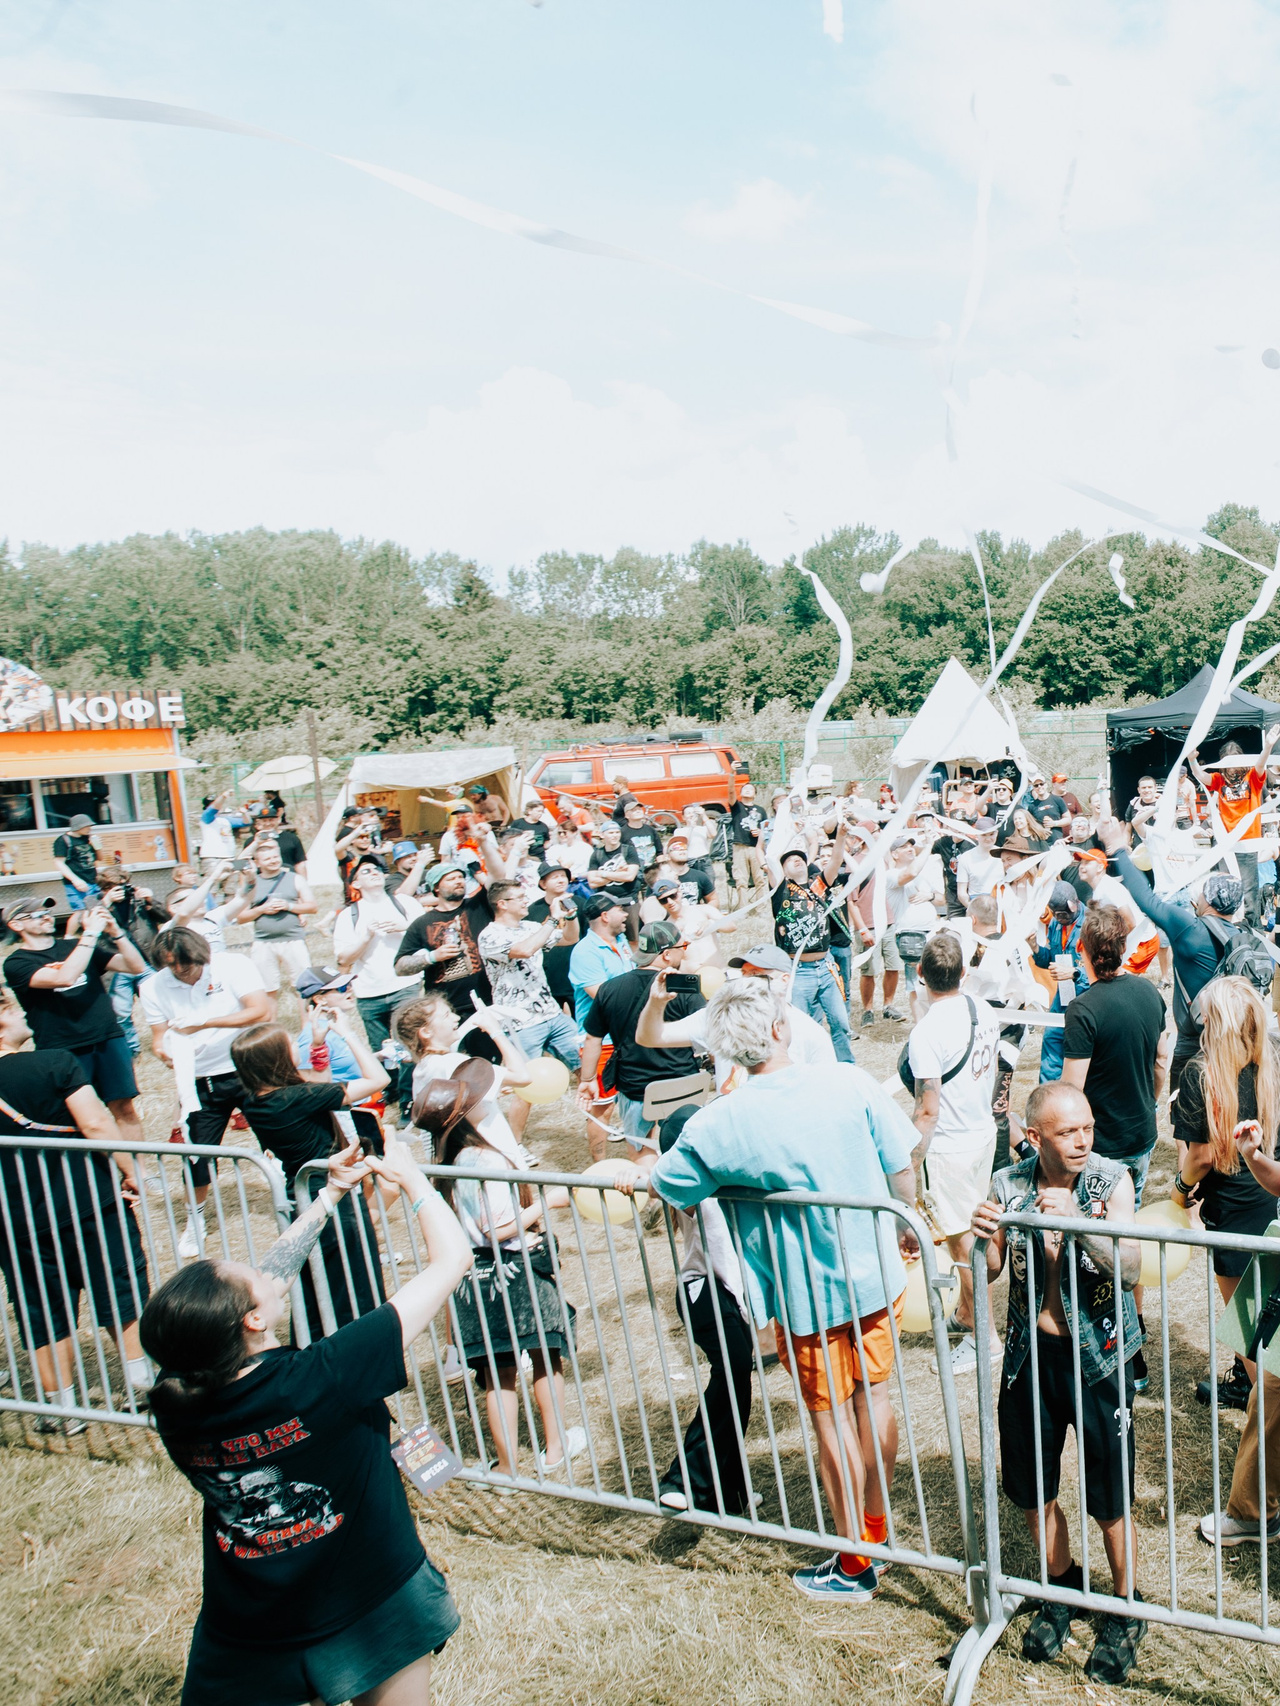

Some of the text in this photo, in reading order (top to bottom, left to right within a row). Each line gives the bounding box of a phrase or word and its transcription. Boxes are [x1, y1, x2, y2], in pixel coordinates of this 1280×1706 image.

[57, 696, 186, 724] КОФЕ
[221, 1416, 304, 1453] ЧТО МЫ
[253, 1428, 311, 1459] ПАРА
